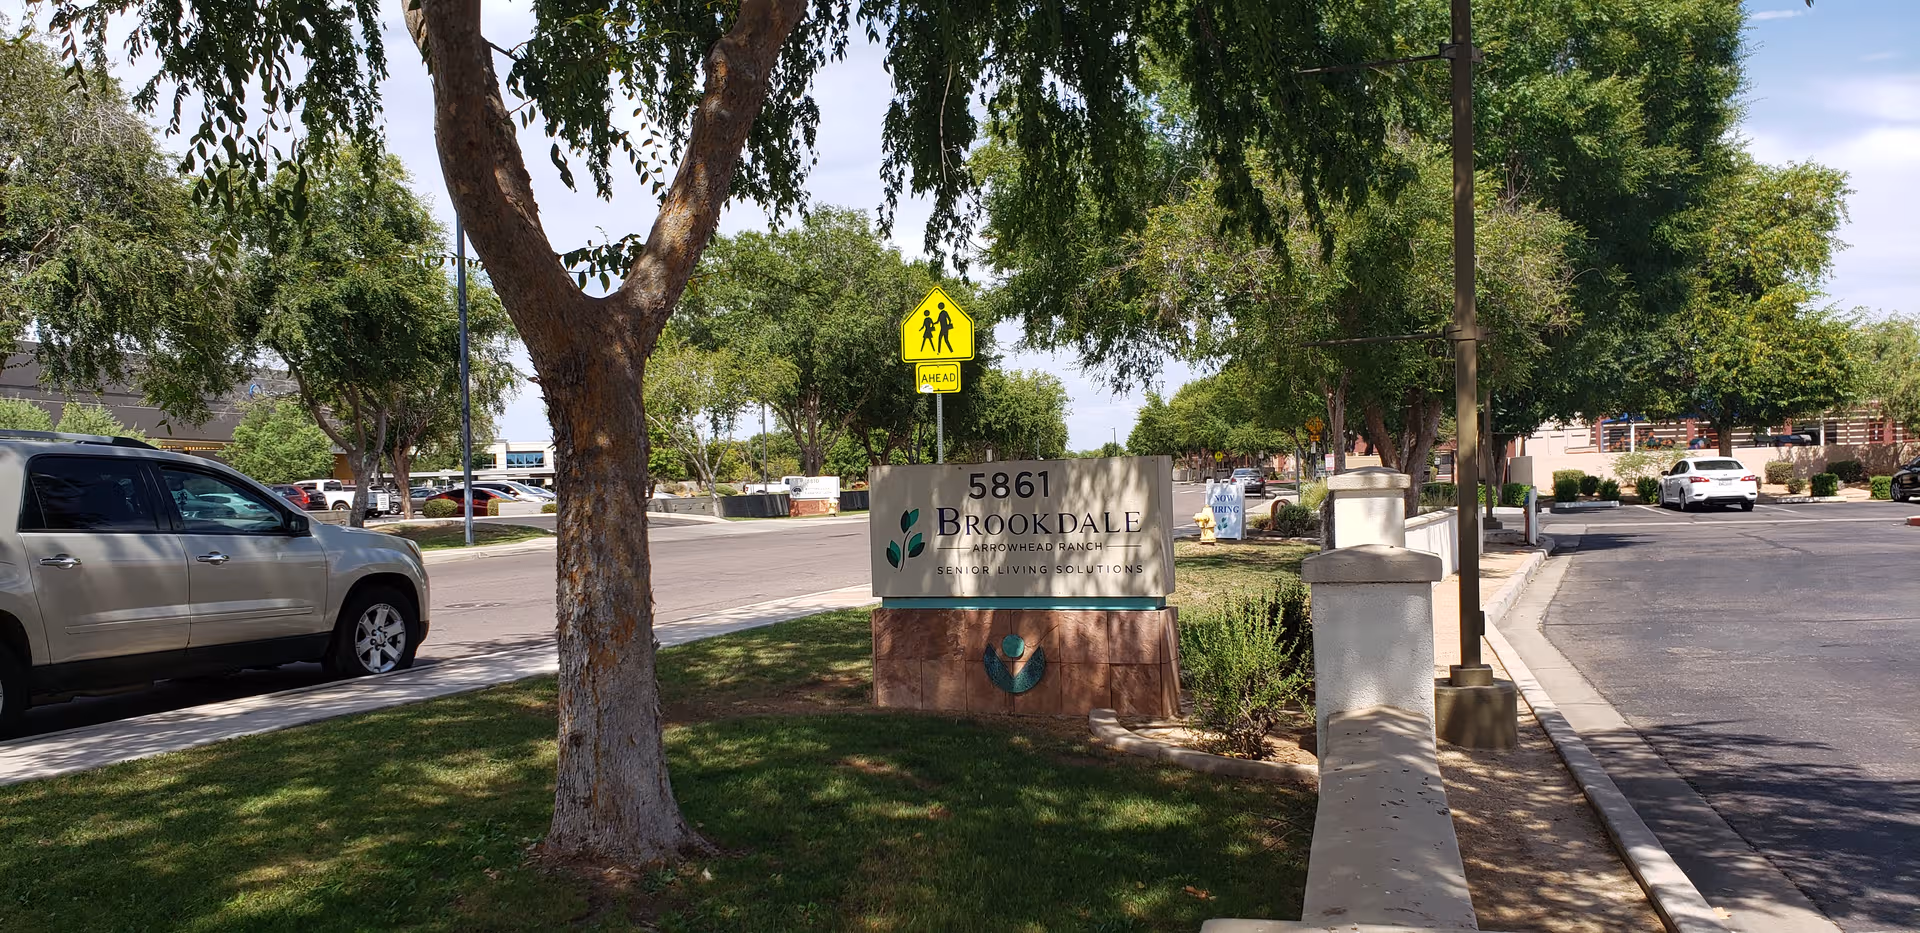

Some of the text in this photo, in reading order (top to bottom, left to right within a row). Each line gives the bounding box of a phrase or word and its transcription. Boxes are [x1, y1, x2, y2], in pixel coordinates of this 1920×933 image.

[921, 373, 956, 383] AHEAD
[969, 470, 1049, 499] 5861
[1214, 494, 1235, 503] NOW
[936, 507, 1142, 536] BROOKDALE
[972, 541, 1103, 553] ARROWHEAD RANCH
[937, 564, 1143, 575] SENIOR LIVING SOLUTIONS
